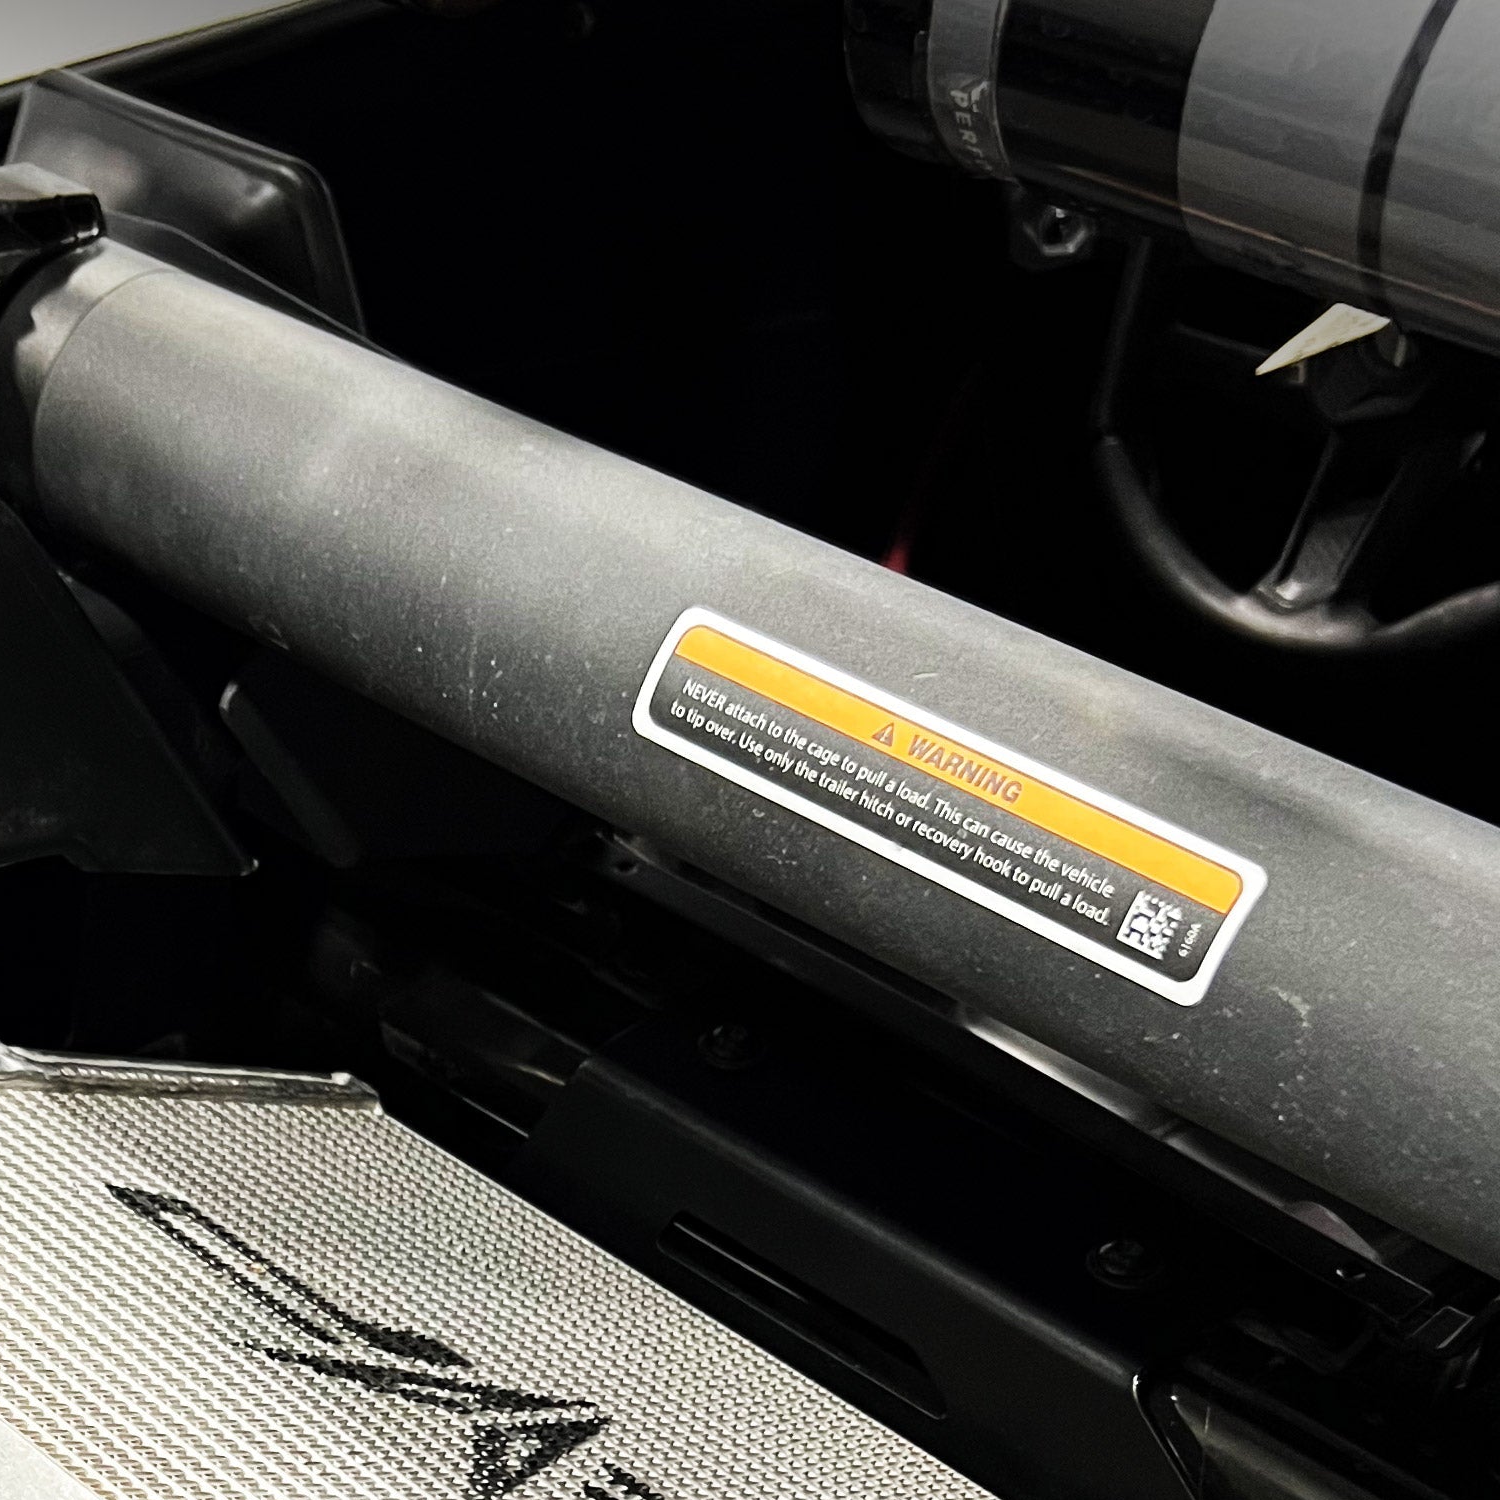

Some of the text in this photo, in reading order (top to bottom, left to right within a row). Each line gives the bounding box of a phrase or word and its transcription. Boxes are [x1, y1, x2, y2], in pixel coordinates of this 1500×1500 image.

[670, 699, 1110, 926] to tip over. Use only the trailer hitch or recovery hook to pull a load.
[682, 677, 1116, 898] NEVER attach to the cage to pull a load. This can cause the vehicle
[908, 734, 1022, 803] WARNING
